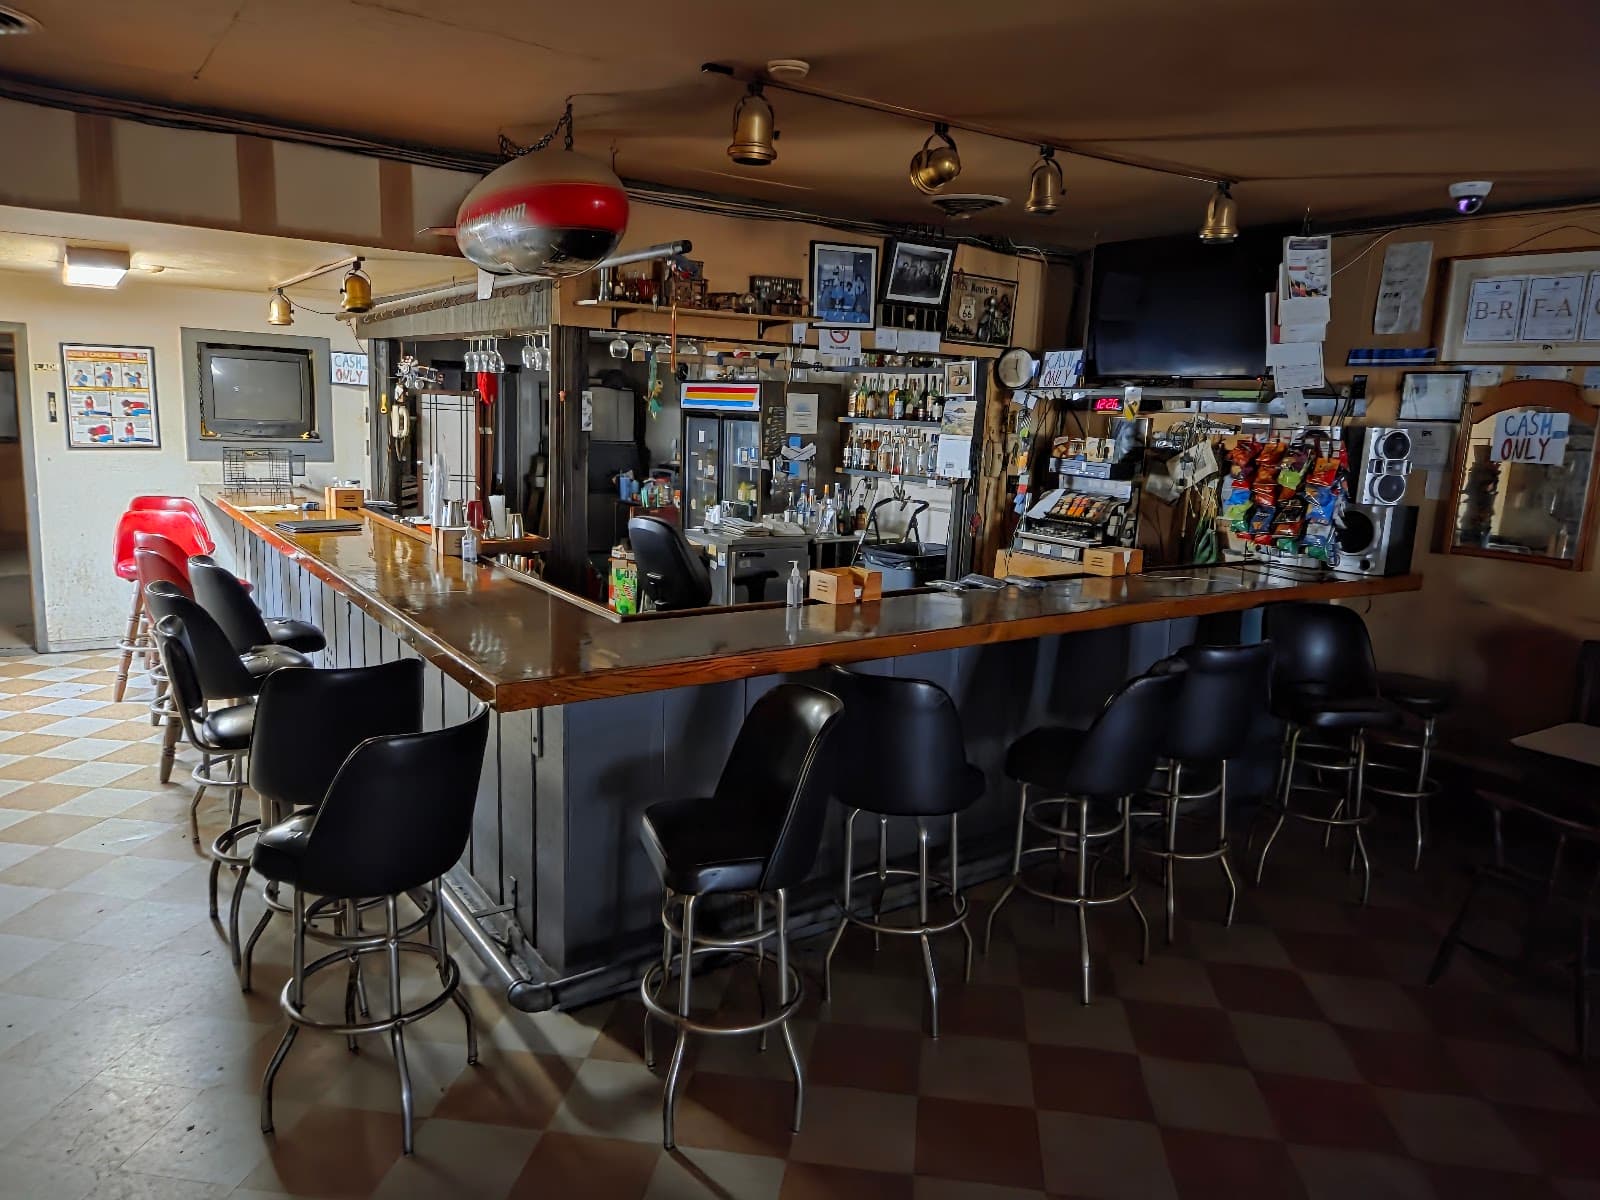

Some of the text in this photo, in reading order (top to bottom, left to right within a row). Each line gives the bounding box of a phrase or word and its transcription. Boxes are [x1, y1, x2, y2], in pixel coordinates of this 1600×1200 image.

[962, 309, 972, 319] 66
[1474, 300, 1513, 320] B-R
[1532, 297, 1572, 318] F-A
[335, 355, 362, 370] CASH
[1047, 352, 1075, 369] CASH
[336, 368, 363, 383] ONLY
[1044, 368, 1072, 386] ONLY
[1504, 414, 1553, 436] CASH
[1501, 437, 1551, 461] ONLY
